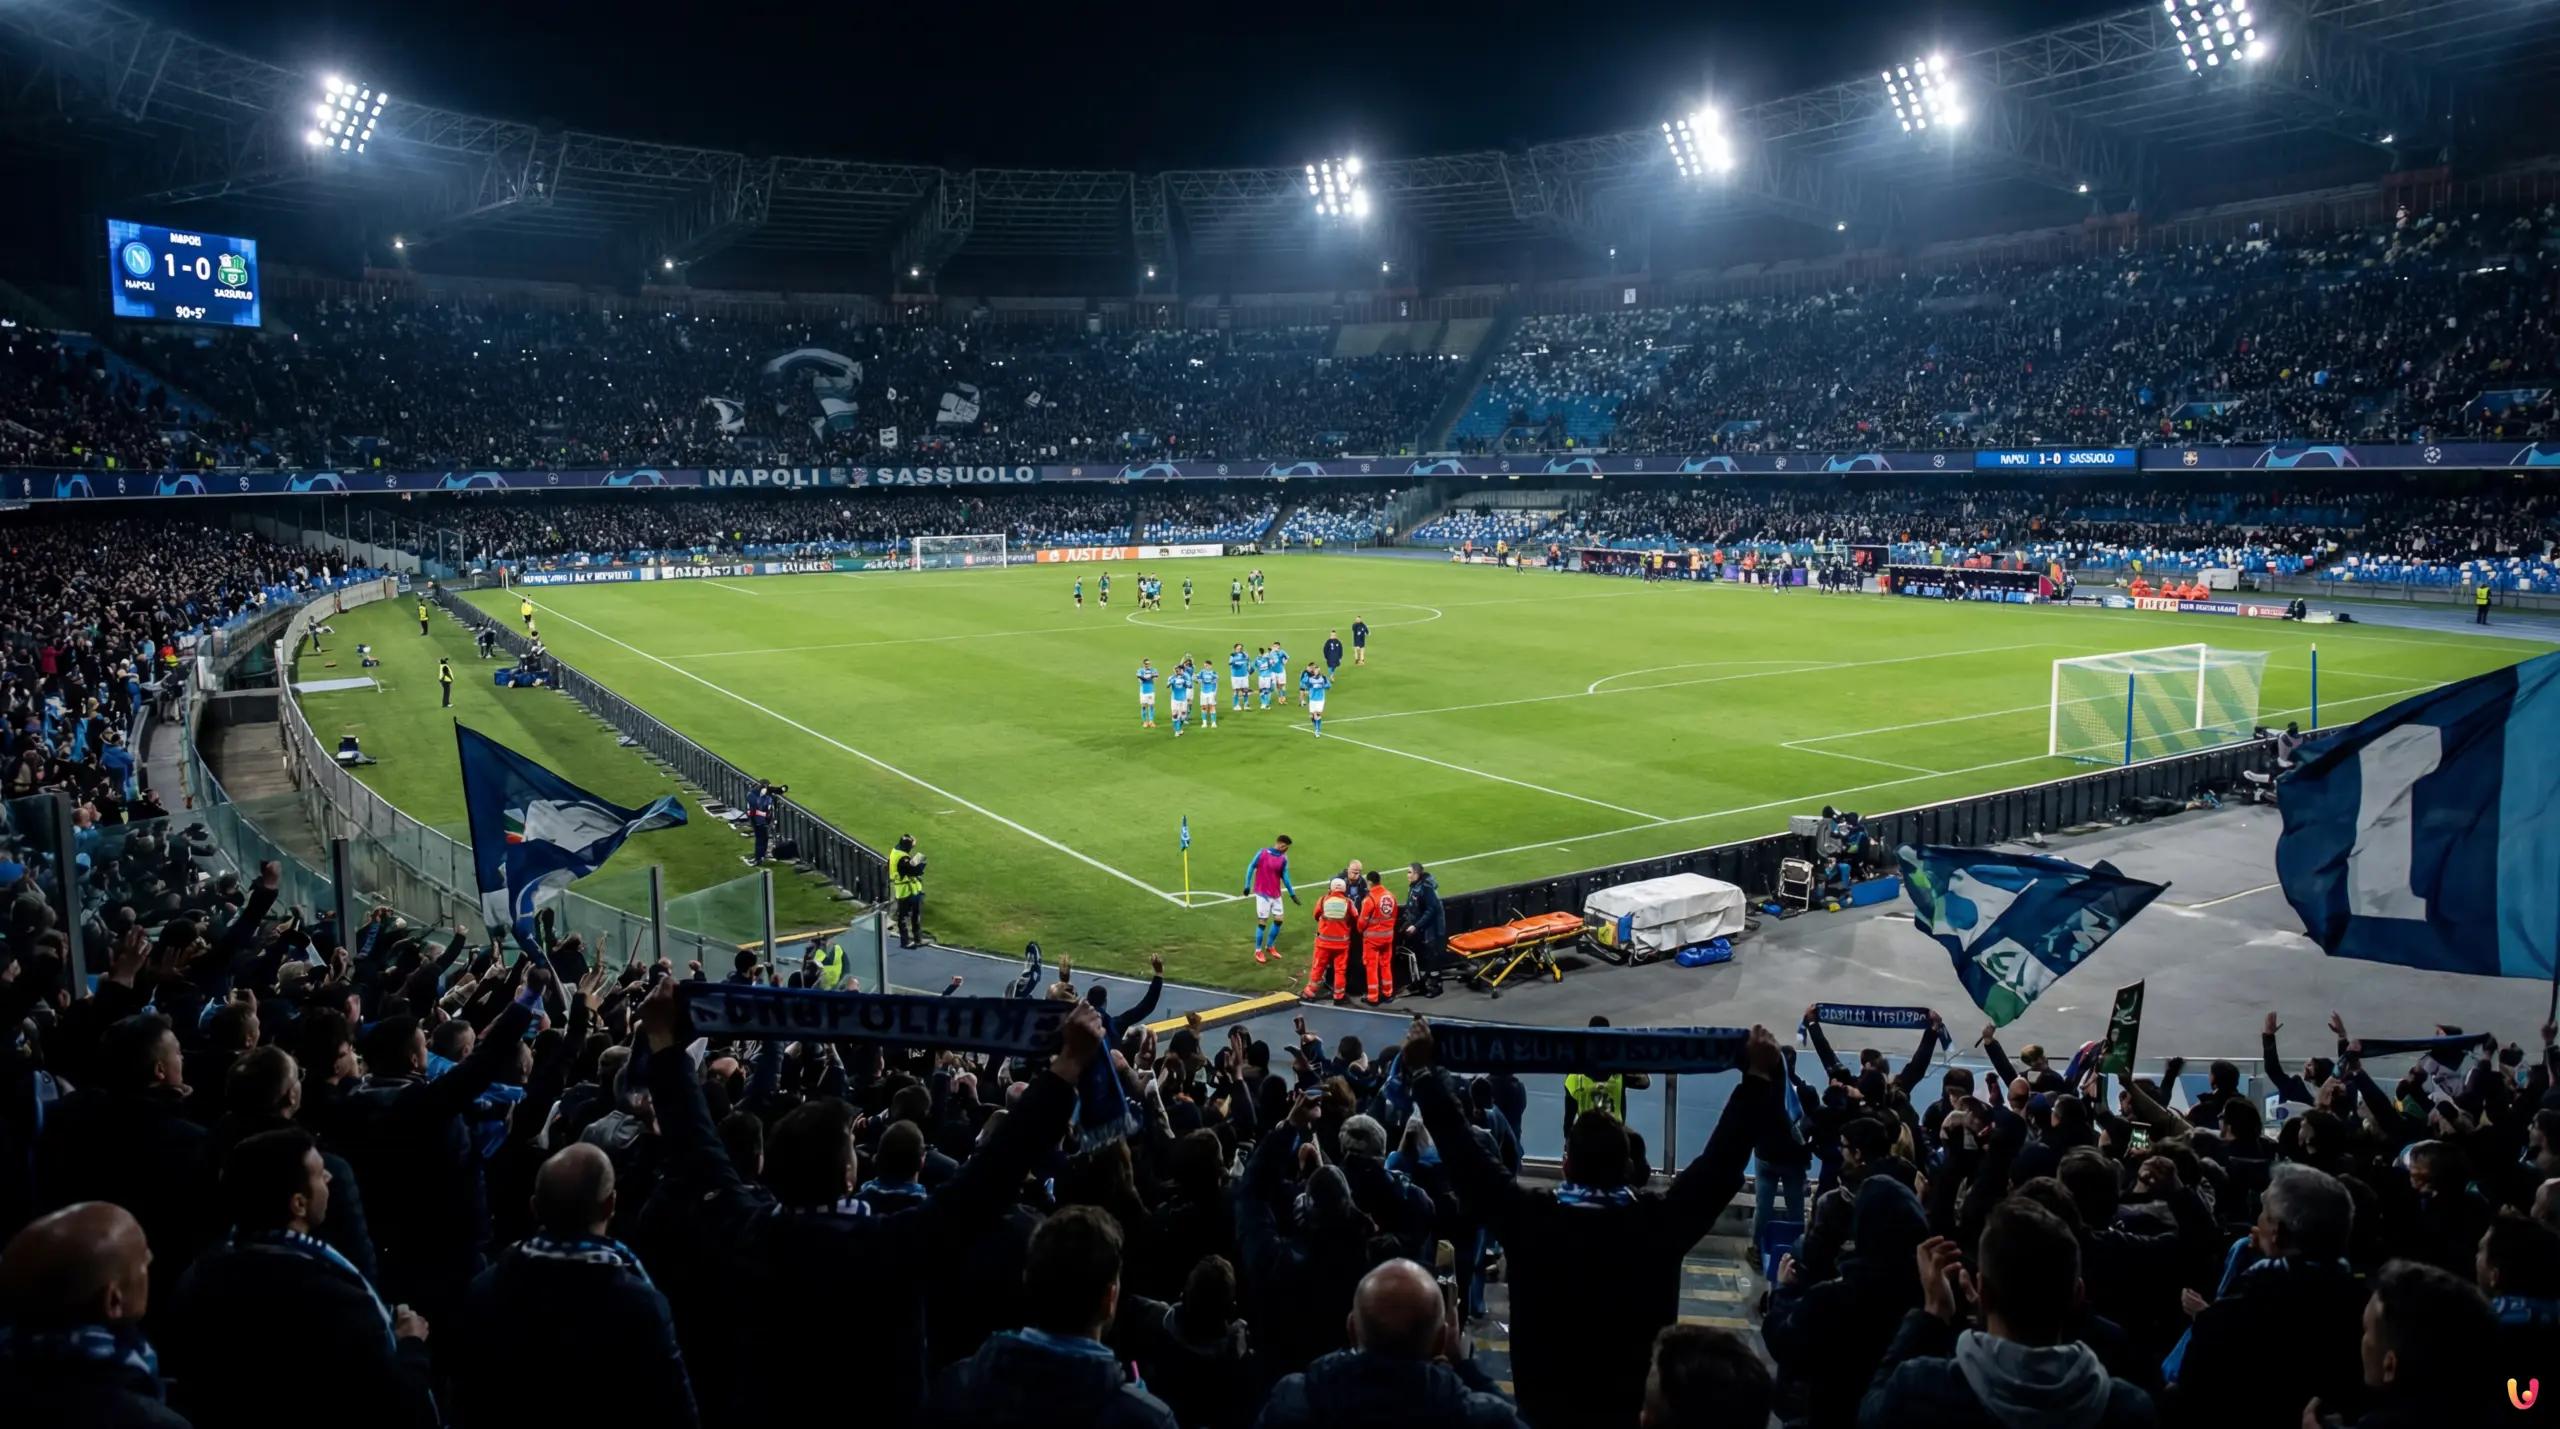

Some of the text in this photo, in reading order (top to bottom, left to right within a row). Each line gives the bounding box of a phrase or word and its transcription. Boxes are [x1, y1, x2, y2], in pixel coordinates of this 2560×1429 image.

[125, 279, 155, 291] NAPOLI
[2069, 453, 2115, 464] SASSUOLO
[708, 466, 1034, 486] NAPOLI SASSUOLO
[1065, 547, 1129, 563] JUST EAT
